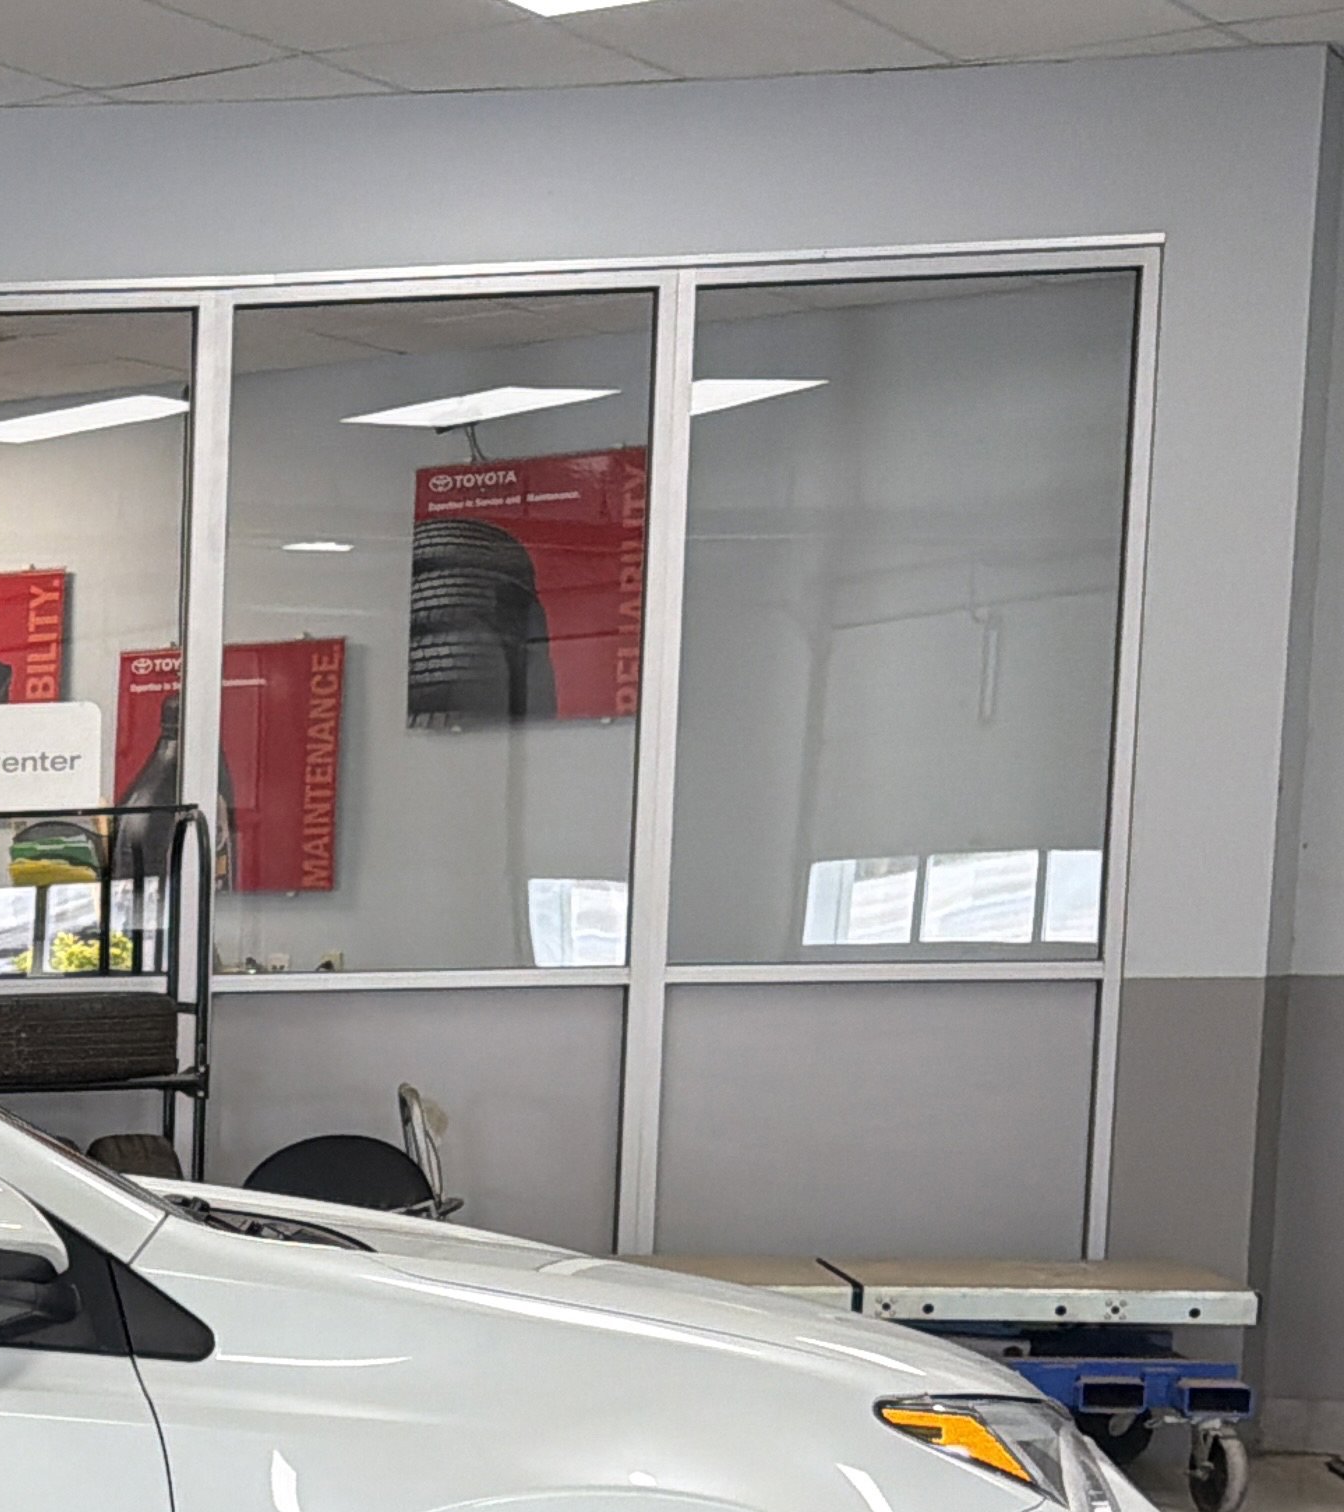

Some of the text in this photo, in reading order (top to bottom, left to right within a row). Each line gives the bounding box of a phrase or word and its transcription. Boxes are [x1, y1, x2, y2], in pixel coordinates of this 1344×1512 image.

[454, 470, 517, 488] TOYOTA
[26, 578, 60, 700] BILITY.
[153, 657, 182, 672] TOY
